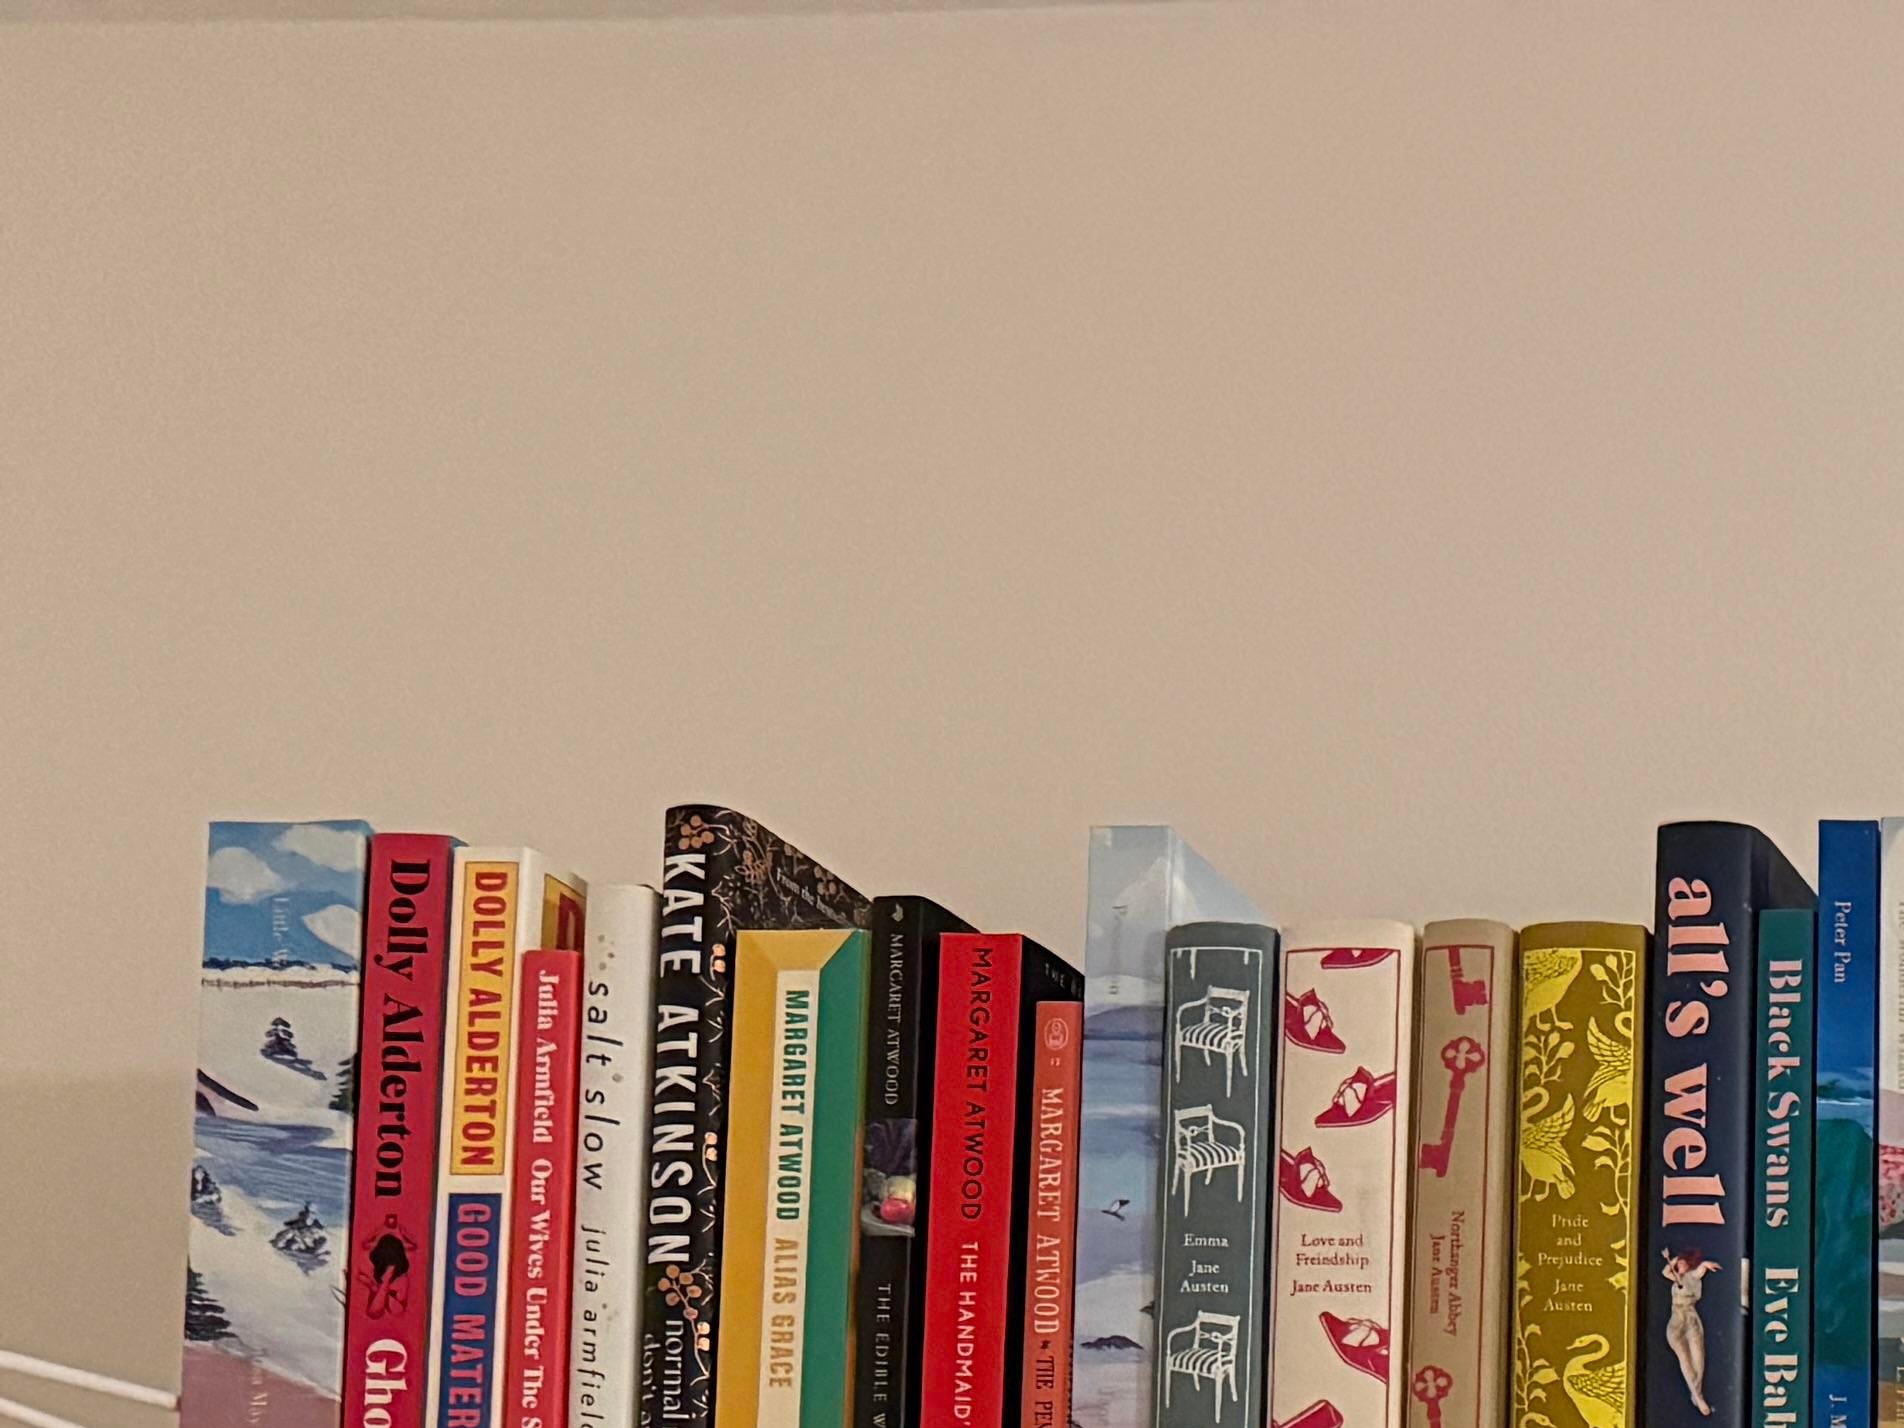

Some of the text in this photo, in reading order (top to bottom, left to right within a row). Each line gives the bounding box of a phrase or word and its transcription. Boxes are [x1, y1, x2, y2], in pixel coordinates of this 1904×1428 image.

[371, 858, 434, 1197] Dolly Alderton
[1661, 875, 1733, 1227] all's well
[958, 946, 995, 1222] MARGARET ATWOOD
[1184, 1234, 1229, 1248] Emma
[1301, 1234, 1364, 1248] Love and
[959, 1240, 979, 1282] THE
[1190, 1260, 1221, 1276] Jane
[1295, 1253, 1370, 1269] Freindship
[1180, 1279, 1229, 1294] Austen
